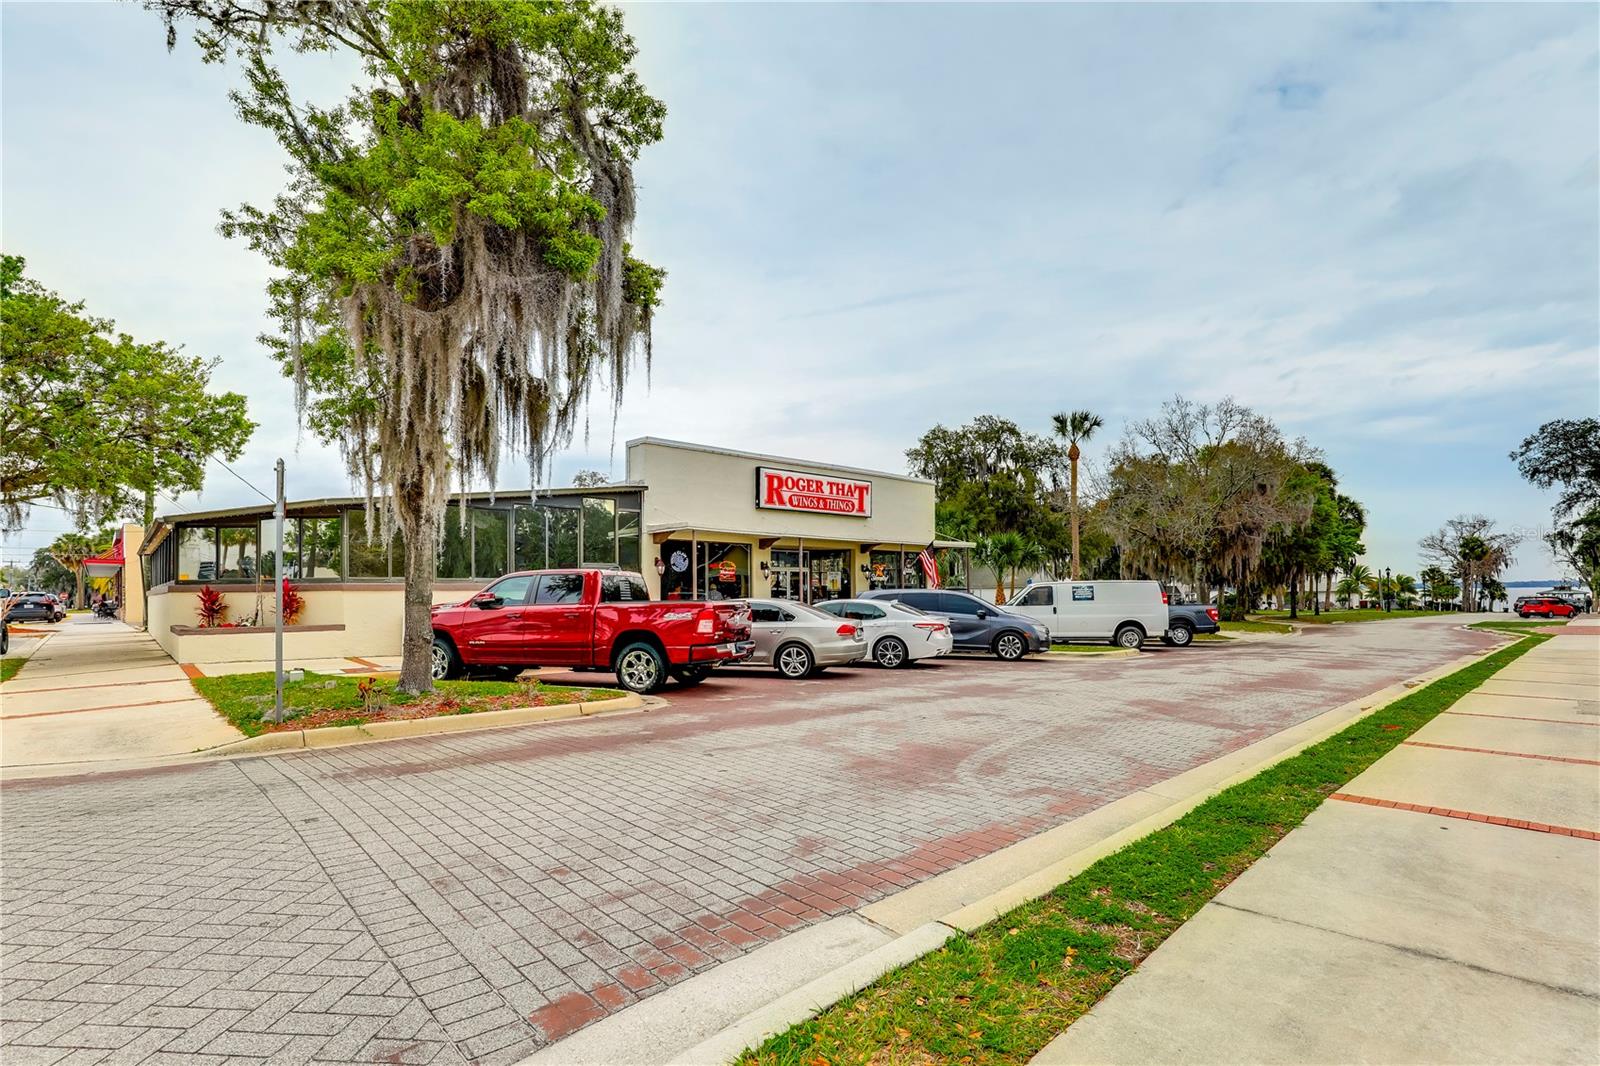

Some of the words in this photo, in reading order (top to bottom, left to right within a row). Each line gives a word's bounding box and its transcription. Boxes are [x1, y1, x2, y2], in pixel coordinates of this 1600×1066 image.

[765, 473, 824, 506] ROGER
[826, 482, 870, 513] THAT
[791, 495, 818, 508] WINGS
[818, 500, 825, 509] &
[826, 499, 853, 511] THINGS
